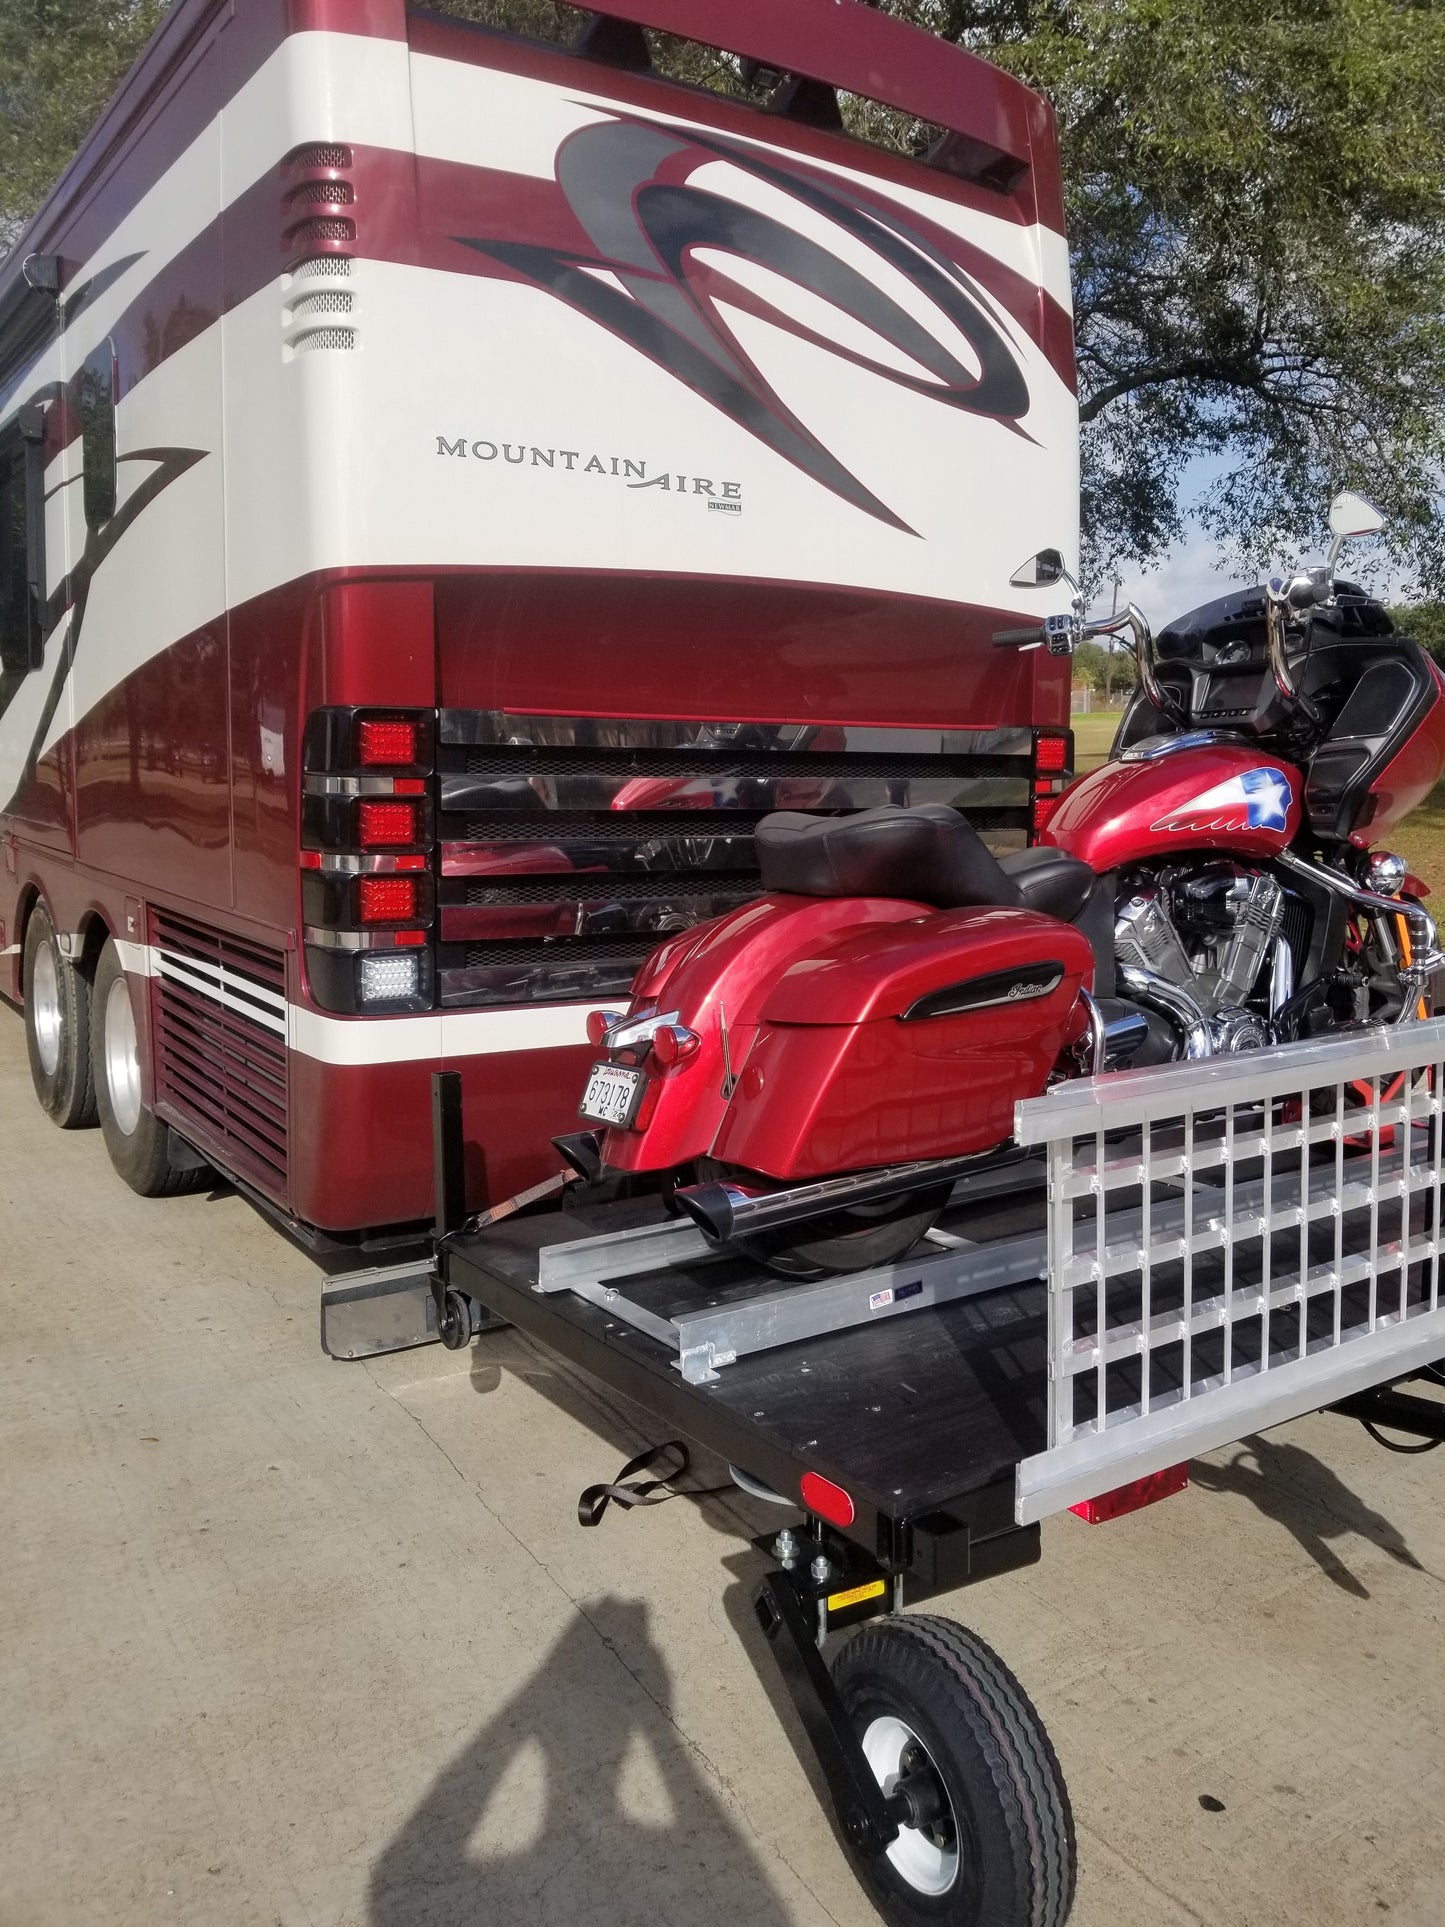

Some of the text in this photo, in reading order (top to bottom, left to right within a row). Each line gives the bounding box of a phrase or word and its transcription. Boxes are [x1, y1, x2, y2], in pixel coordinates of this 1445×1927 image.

[708, 501, 742, 512] NEWMAR
[1008, 982, 1043, 998] Indian
[588, 1080, 631, 1109] 673178
[598, 1105, 608, 1117] MC
